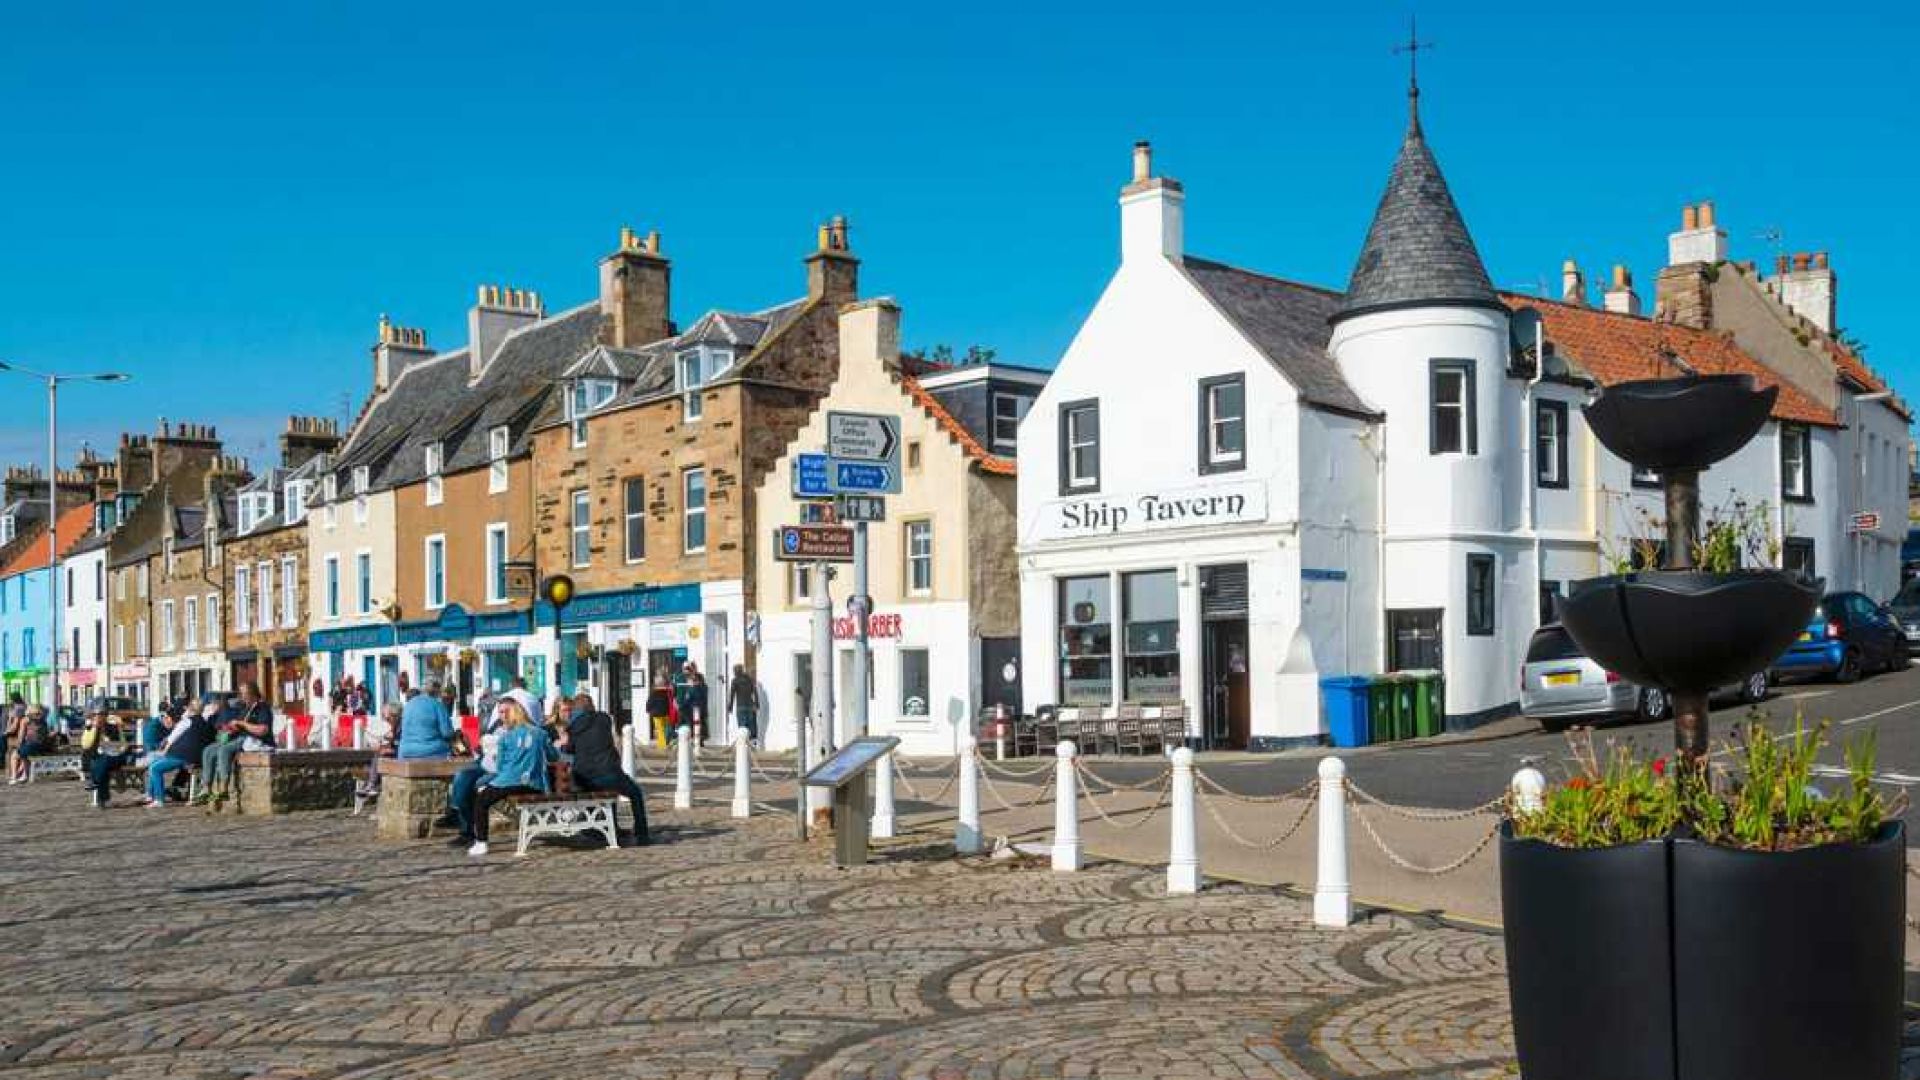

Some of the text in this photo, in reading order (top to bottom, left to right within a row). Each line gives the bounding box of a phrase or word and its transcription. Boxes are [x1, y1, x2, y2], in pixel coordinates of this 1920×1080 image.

[1061, 494, 1245, 532] Ship Tavern
[802, 542, 850, 553] Restaurant
[866, 613, 904, 640] ARBER
